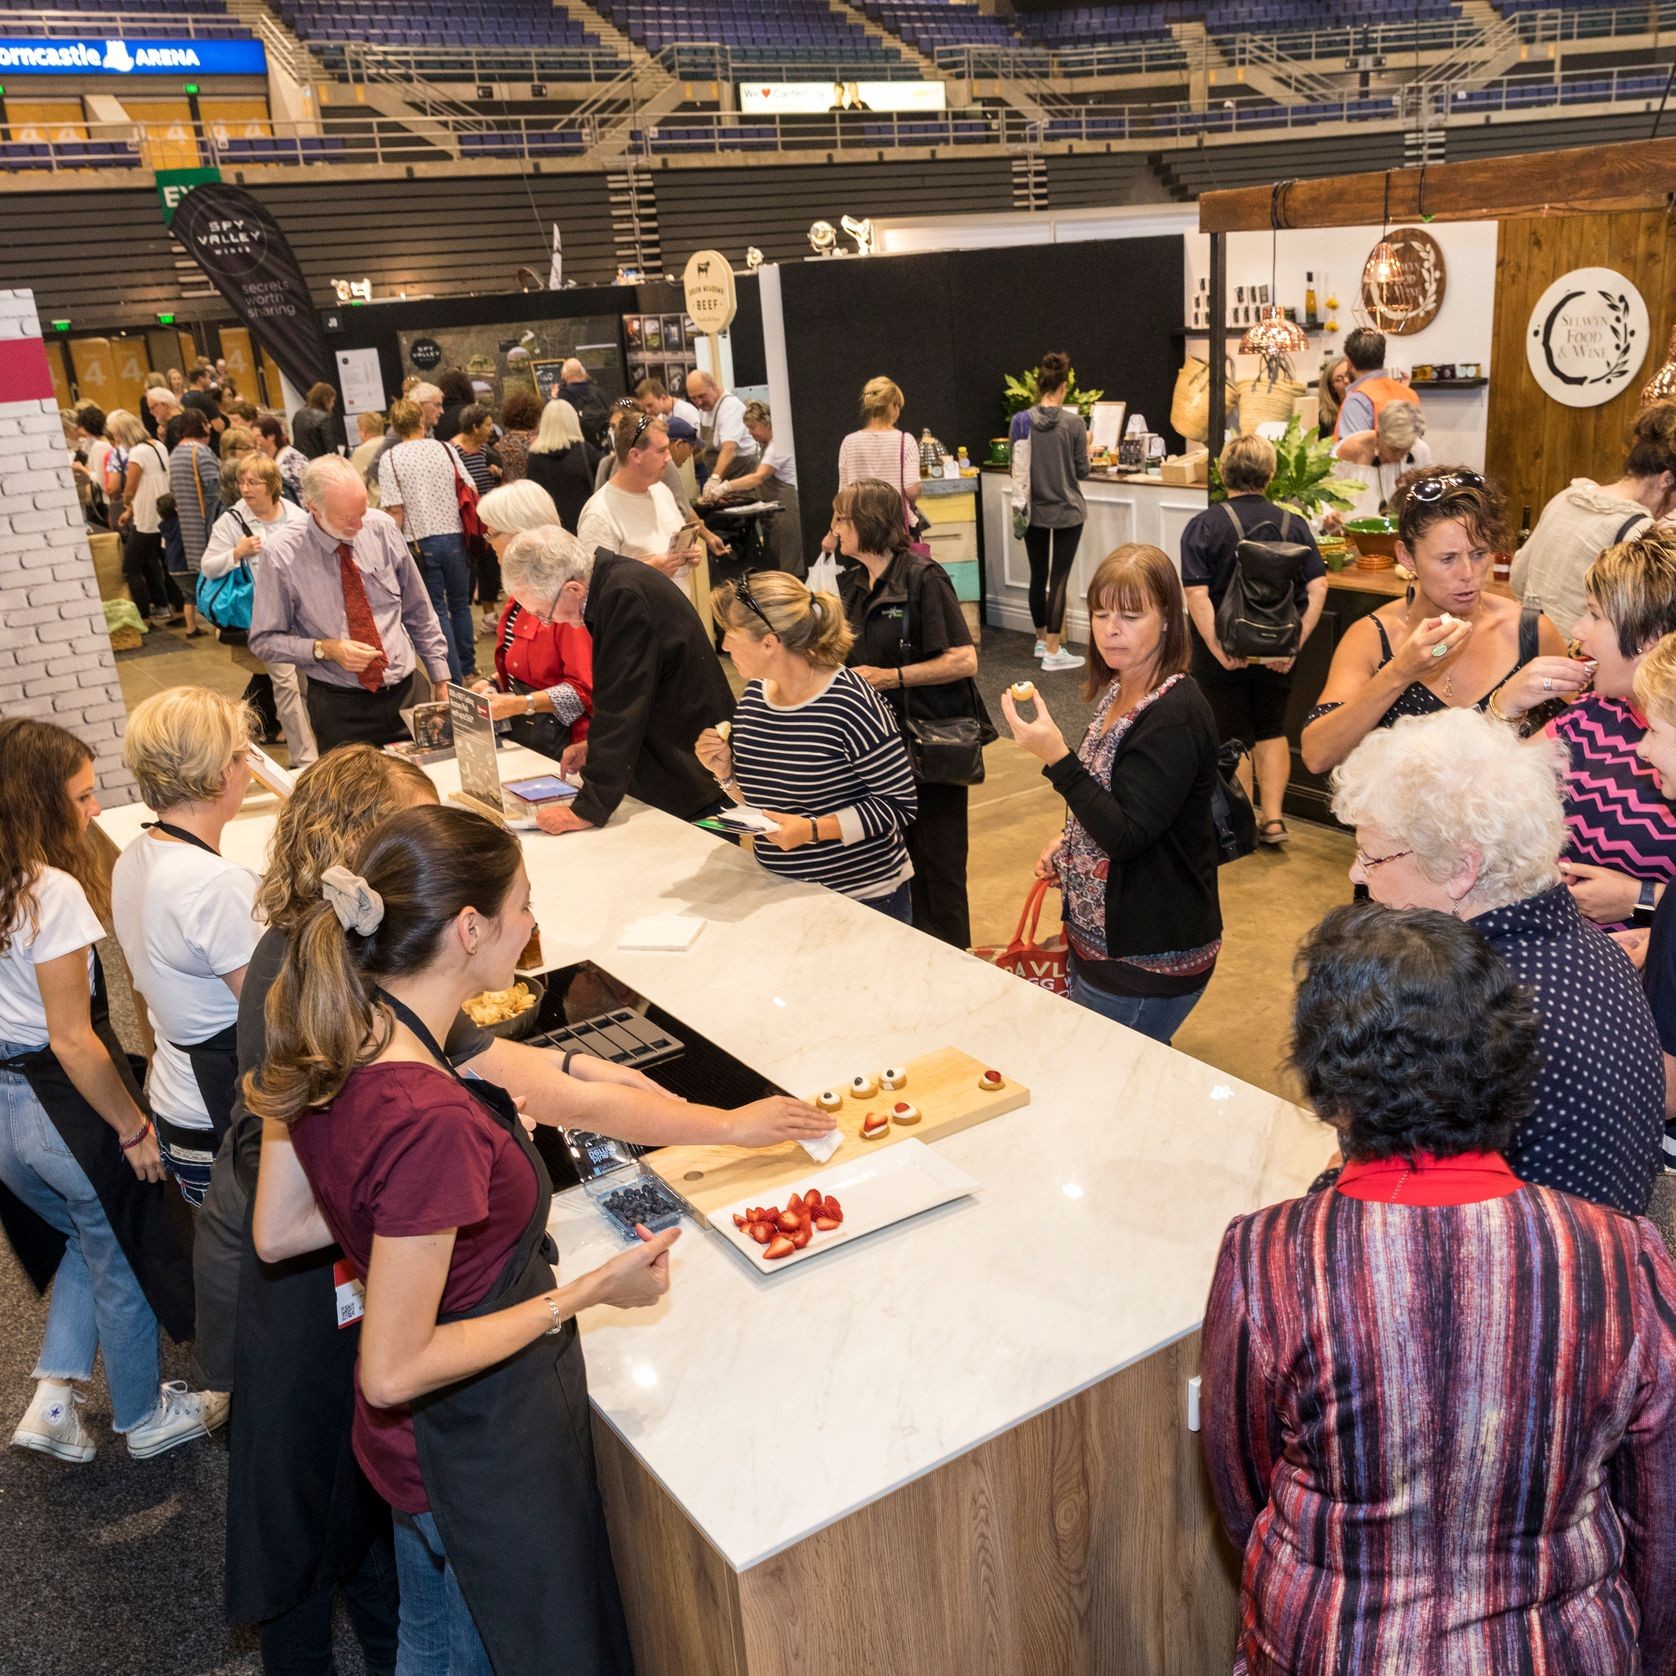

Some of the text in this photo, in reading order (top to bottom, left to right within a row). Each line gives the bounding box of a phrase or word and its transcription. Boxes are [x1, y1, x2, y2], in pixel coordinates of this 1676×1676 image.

[136, 48, 200, 66] ARENA
[208, 219, 245, 233] SPY
[197, 230, 261, 246] VALLEY
[242, 279, 290, 294] secrets
[245, 292, 285, 305] worth
[696, 299, 717, 310] BEEF
[247, 303, 296, 318] sharing
[228, 348, 248, 374] 4
[84, 360, 107, 386] 4
[122, 357, 144, 383] 4
